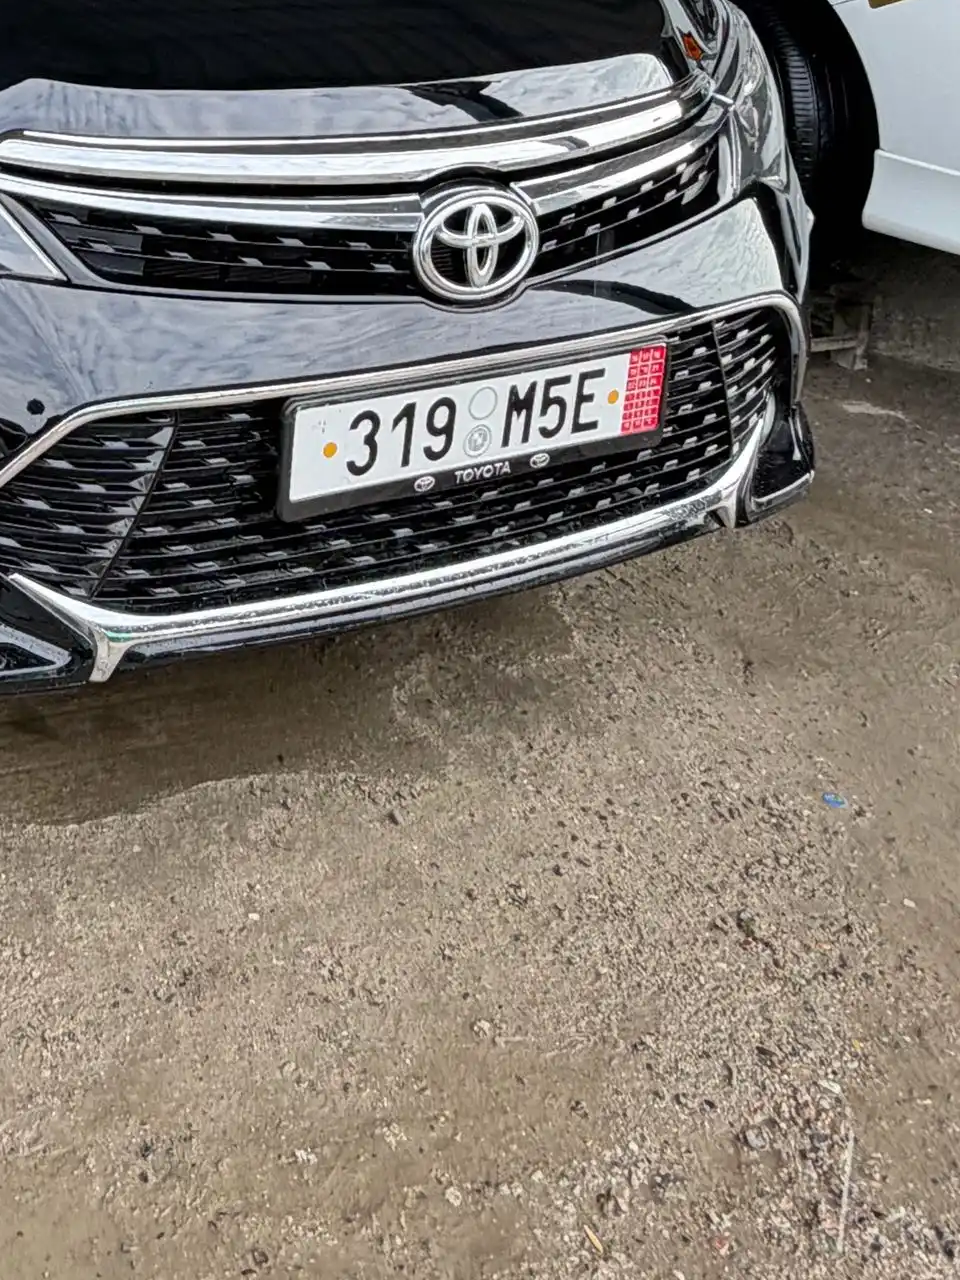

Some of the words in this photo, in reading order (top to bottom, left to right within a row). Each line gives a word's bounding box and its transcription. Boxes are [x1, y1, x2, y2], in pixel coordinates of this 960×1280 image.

[346, 396, 457, 477] 319
[500, 367, 606, 449] M5E
[454, 460, 511, 484] TOYOTA
